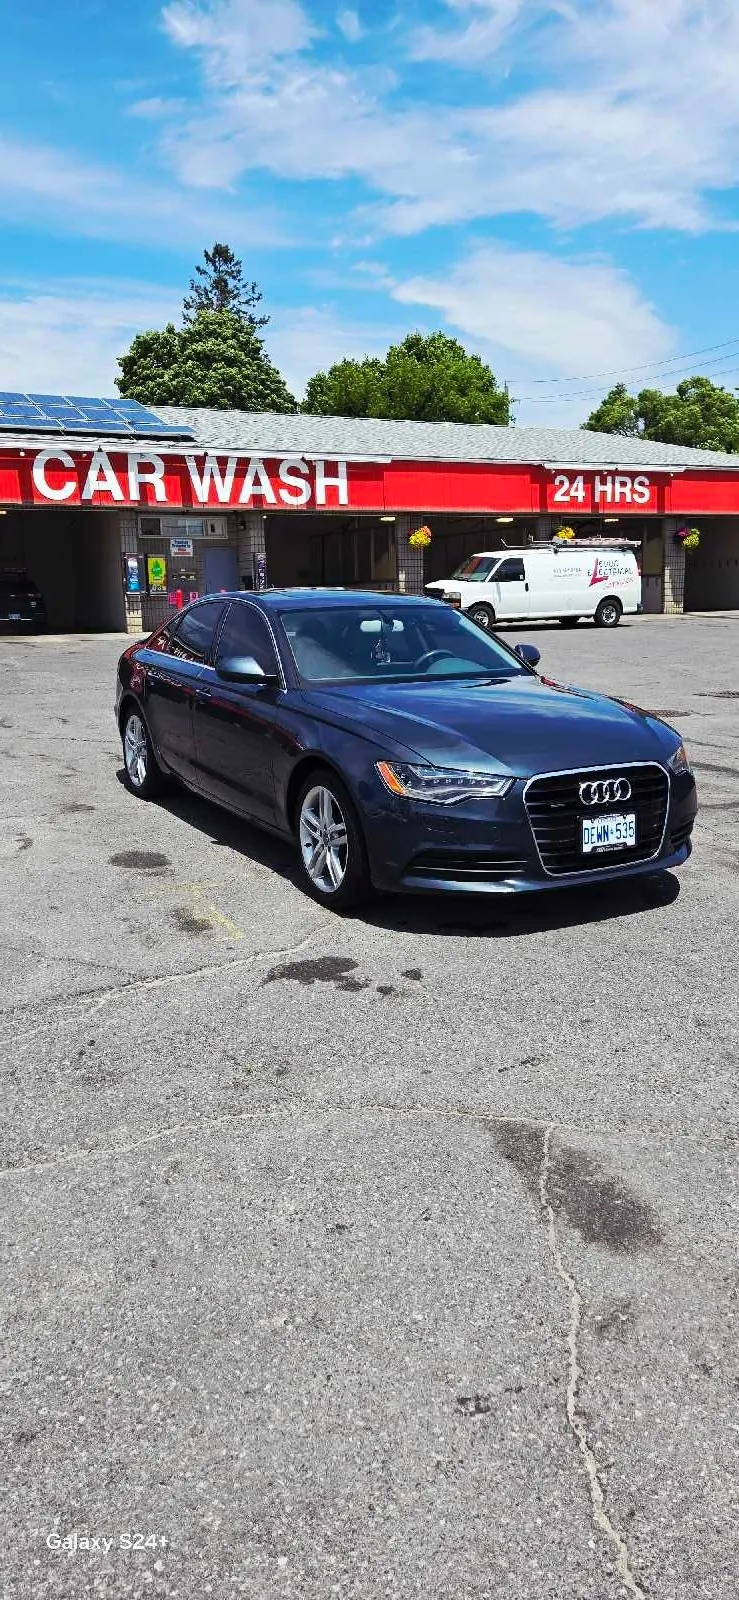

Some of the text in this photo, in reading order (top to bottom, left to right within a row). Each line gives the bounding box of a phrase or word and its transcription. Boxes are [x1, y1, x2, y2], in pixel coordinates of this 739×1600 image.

[32, 449, 349, 505] CAR WASH
[554, 475, 650, 503] 24 HRS
[615, 821, 635, 840] 535
